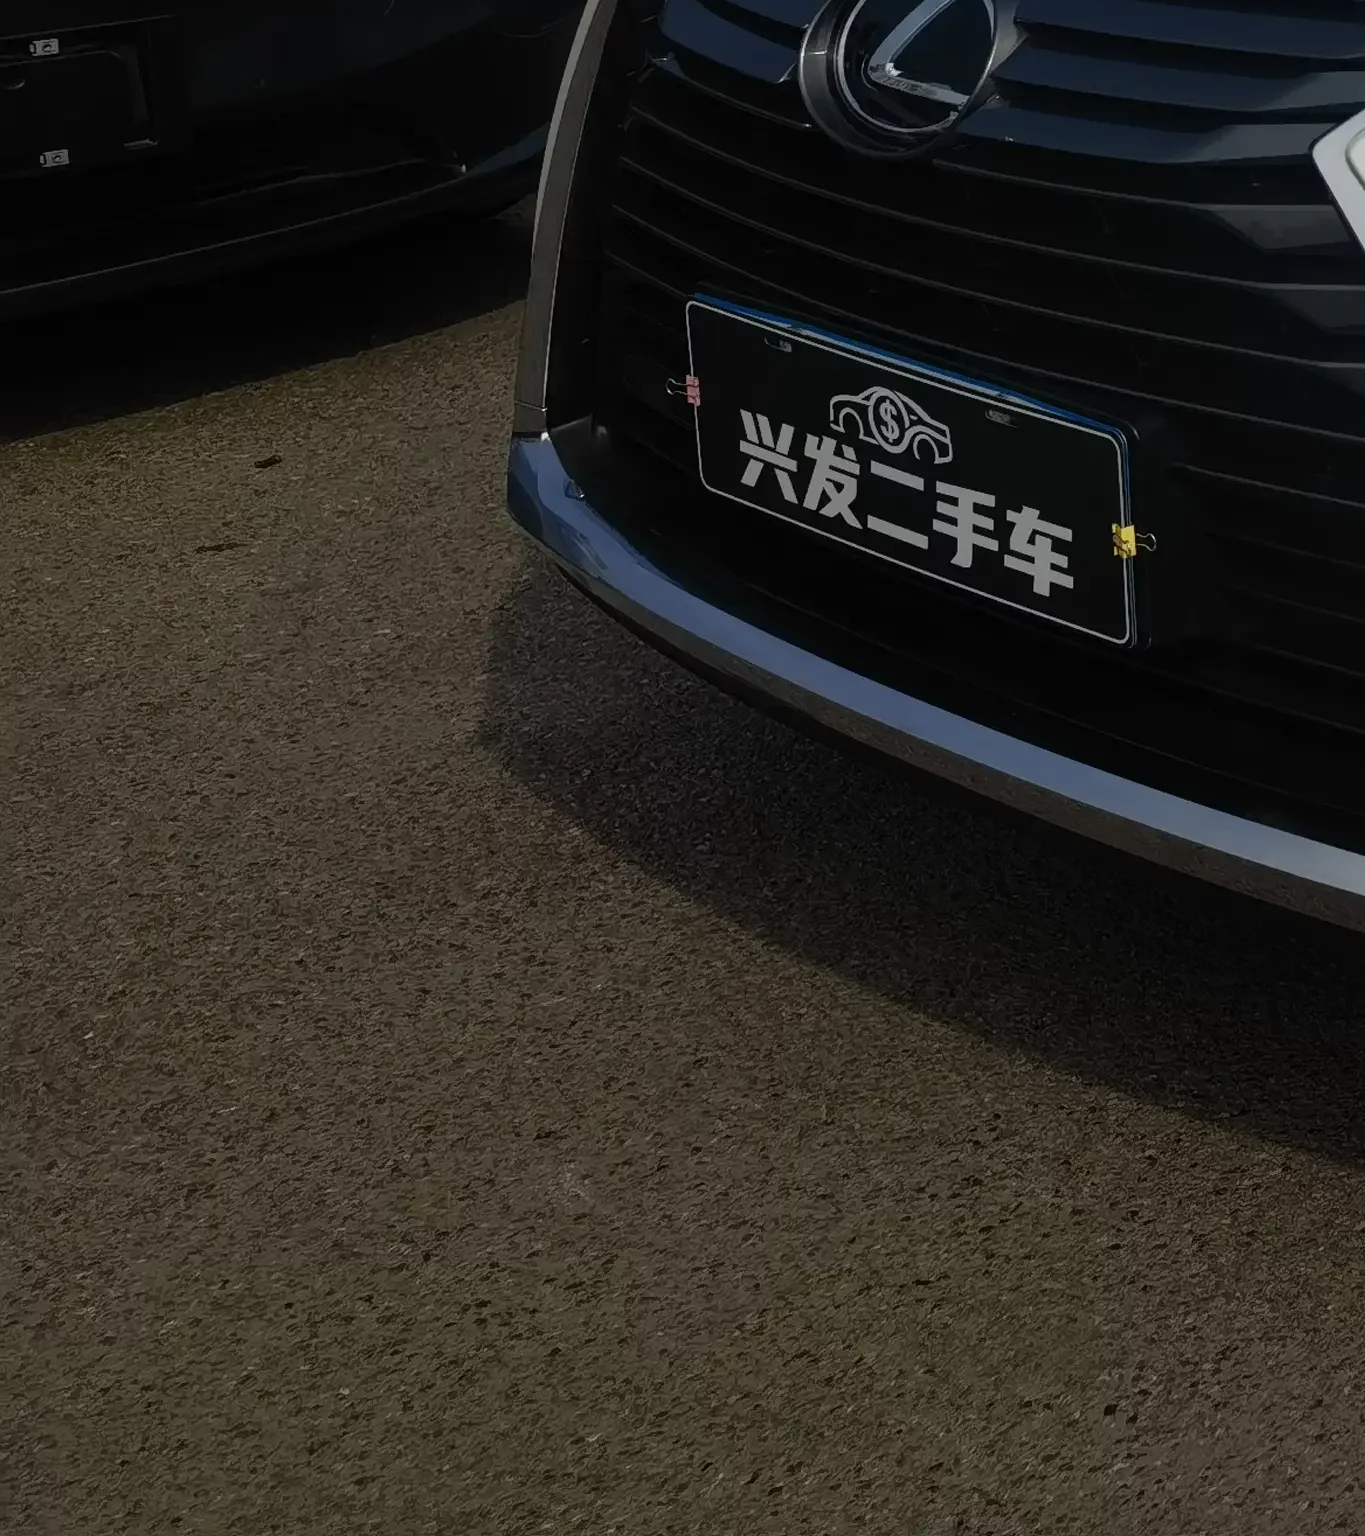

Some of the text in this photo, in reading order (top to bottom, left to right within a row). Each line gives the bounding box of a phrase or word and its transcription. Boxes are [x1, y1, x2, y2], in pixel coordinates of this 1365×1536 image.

[738, 408, 1074, 597] 兴发二手车
